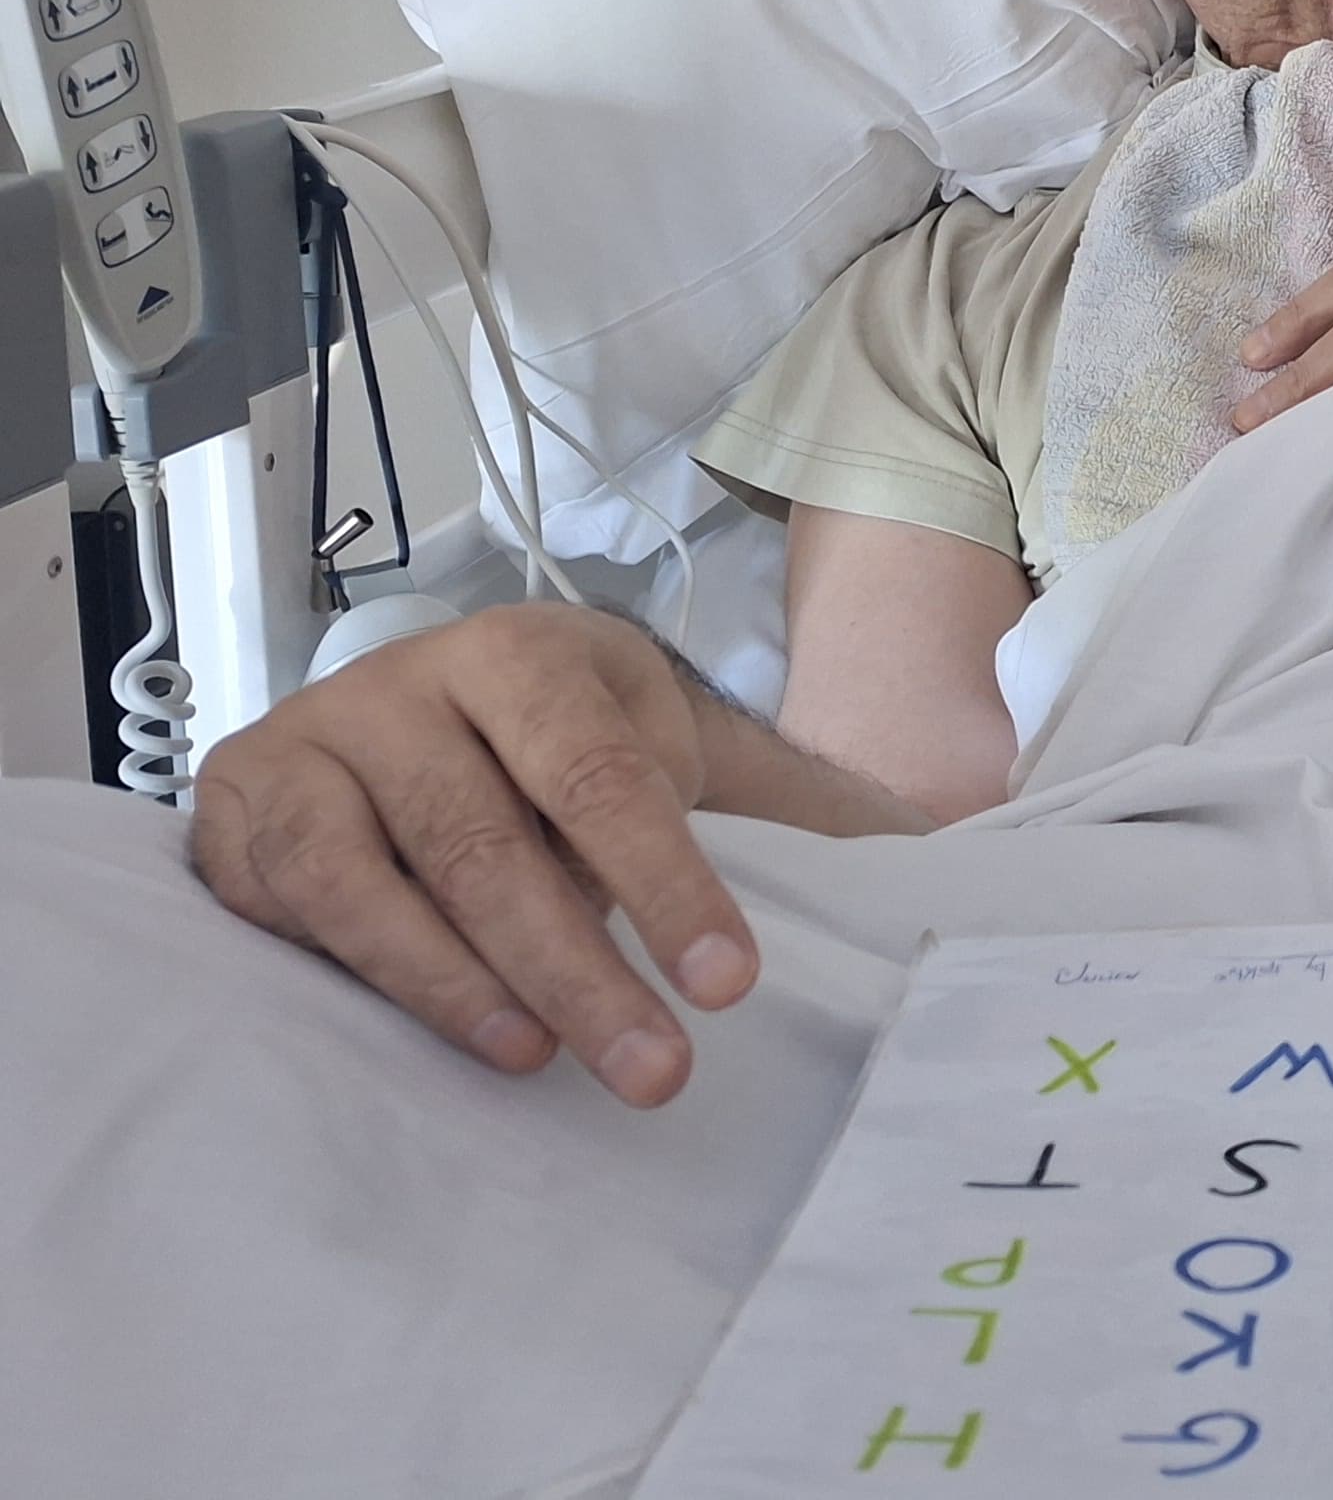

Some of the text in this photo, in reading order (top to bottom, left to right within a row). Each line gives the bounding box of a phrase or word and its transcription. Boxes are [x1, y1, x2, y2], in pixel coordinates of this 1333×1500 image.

[1037, 1035, 1118, 1095] X
[961, 1140, 1081, 1192] T
[1207, 1137, 1303, 1199] S
[940, 1237, 1028, 1289] P
[1172, 1235, 1294, 1296] O
[910, 1307, 1000, 1366] L
[1173, 1308, 1260, 1375] K
[856, 1405, 984, 1472] H
[1120, 1408, 1262, 1479] G
